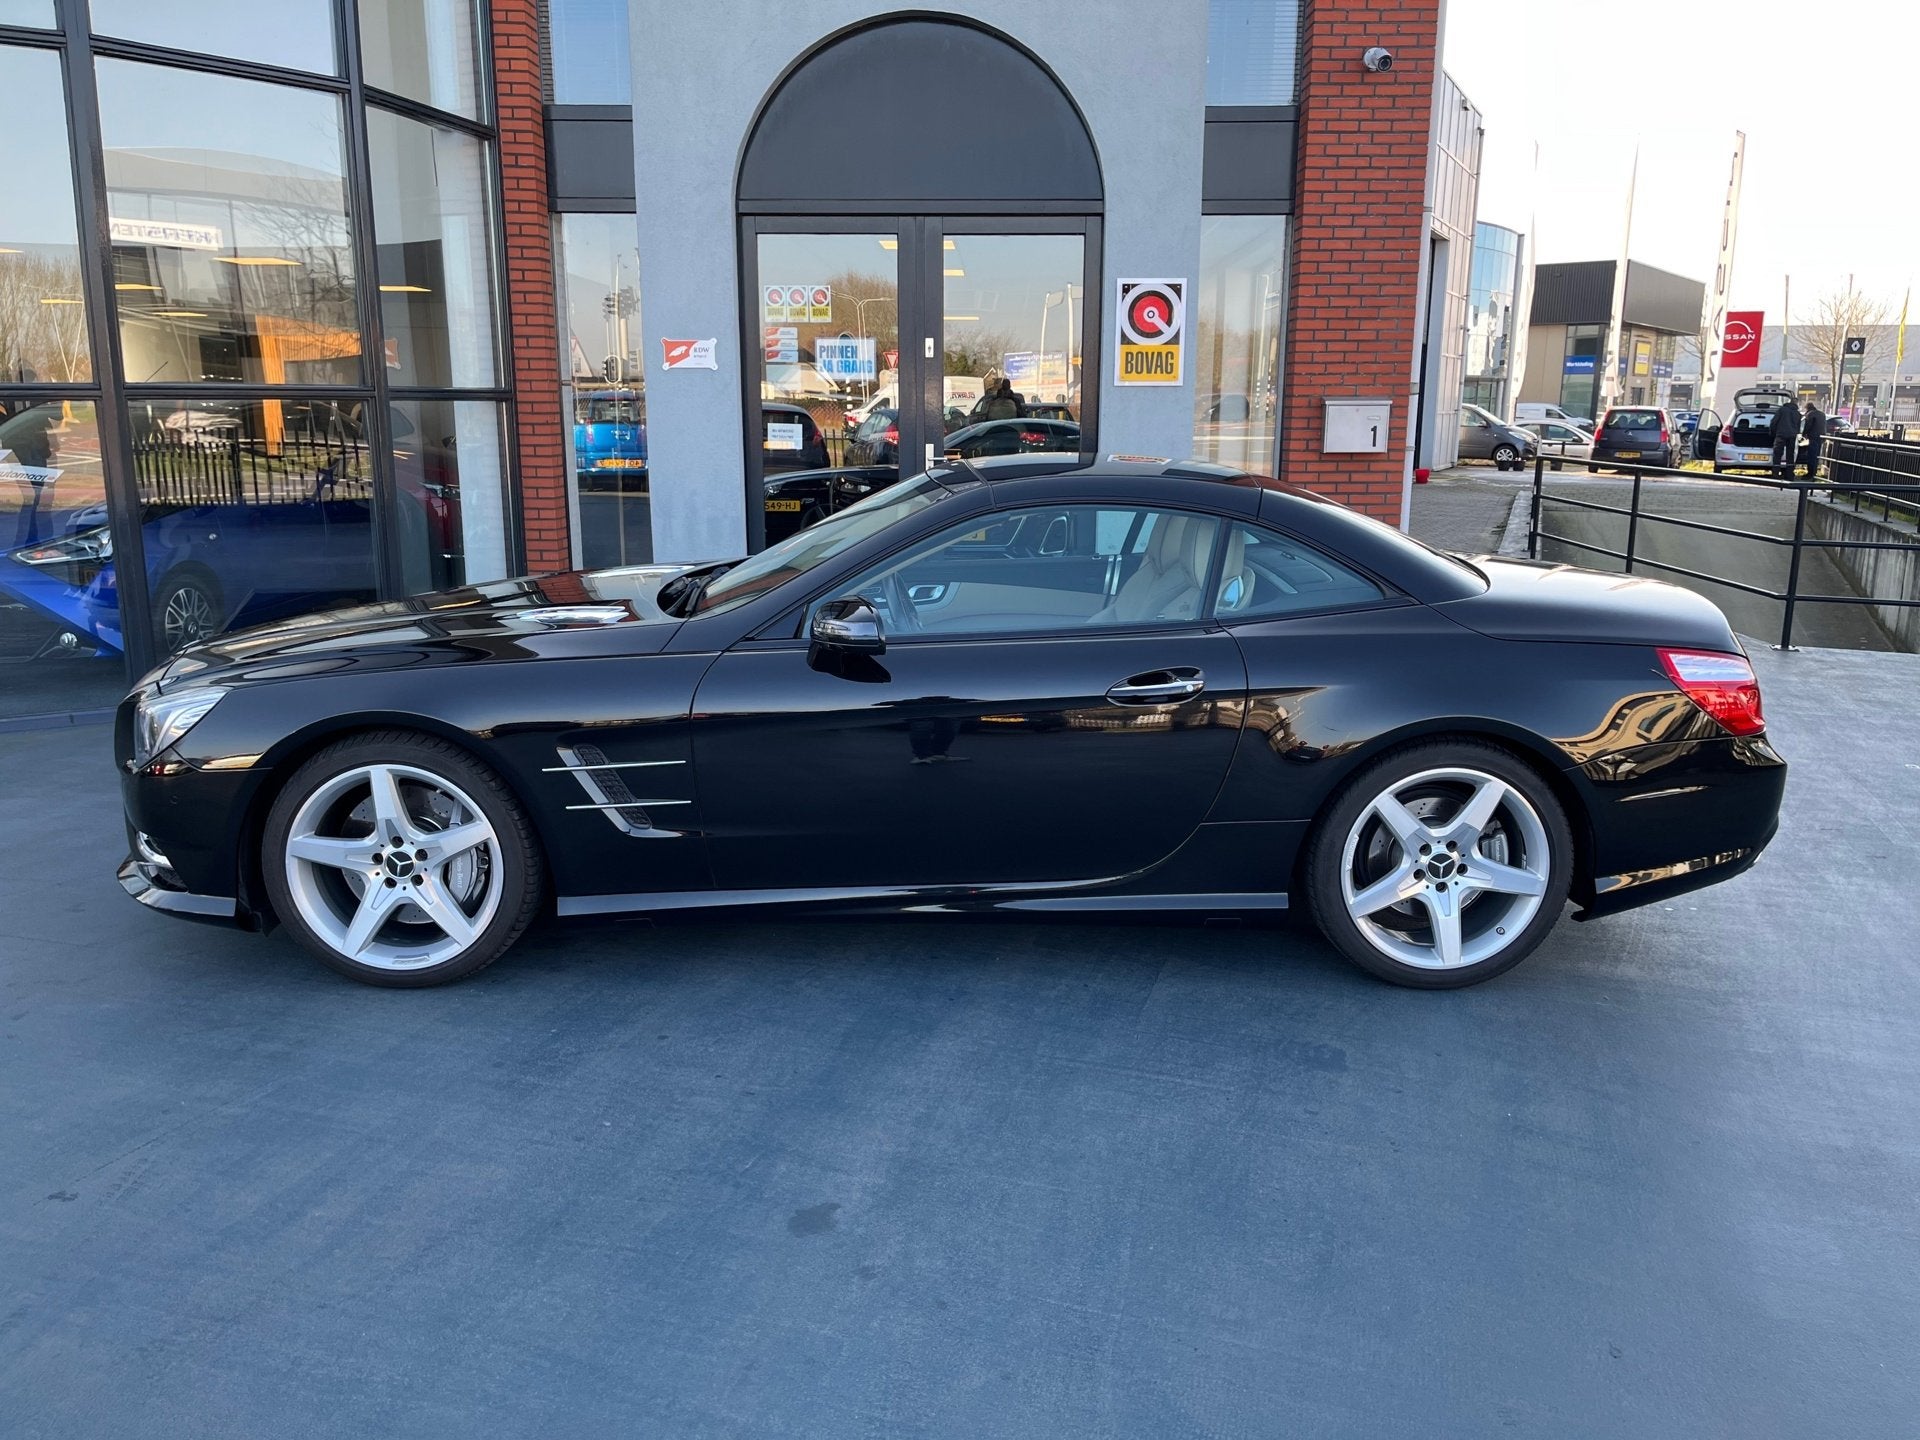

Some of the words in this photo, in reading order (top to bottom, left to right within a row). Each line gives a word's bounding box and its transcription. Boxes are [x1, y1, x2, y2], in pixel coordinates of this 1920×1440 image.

[812, 308, 829, 317] BOVAG
[818, 345, 858, 359] PINNEN
[1124, 351, 1175, 375] BOVAG
[1371, 425, 1377, 447] 1
